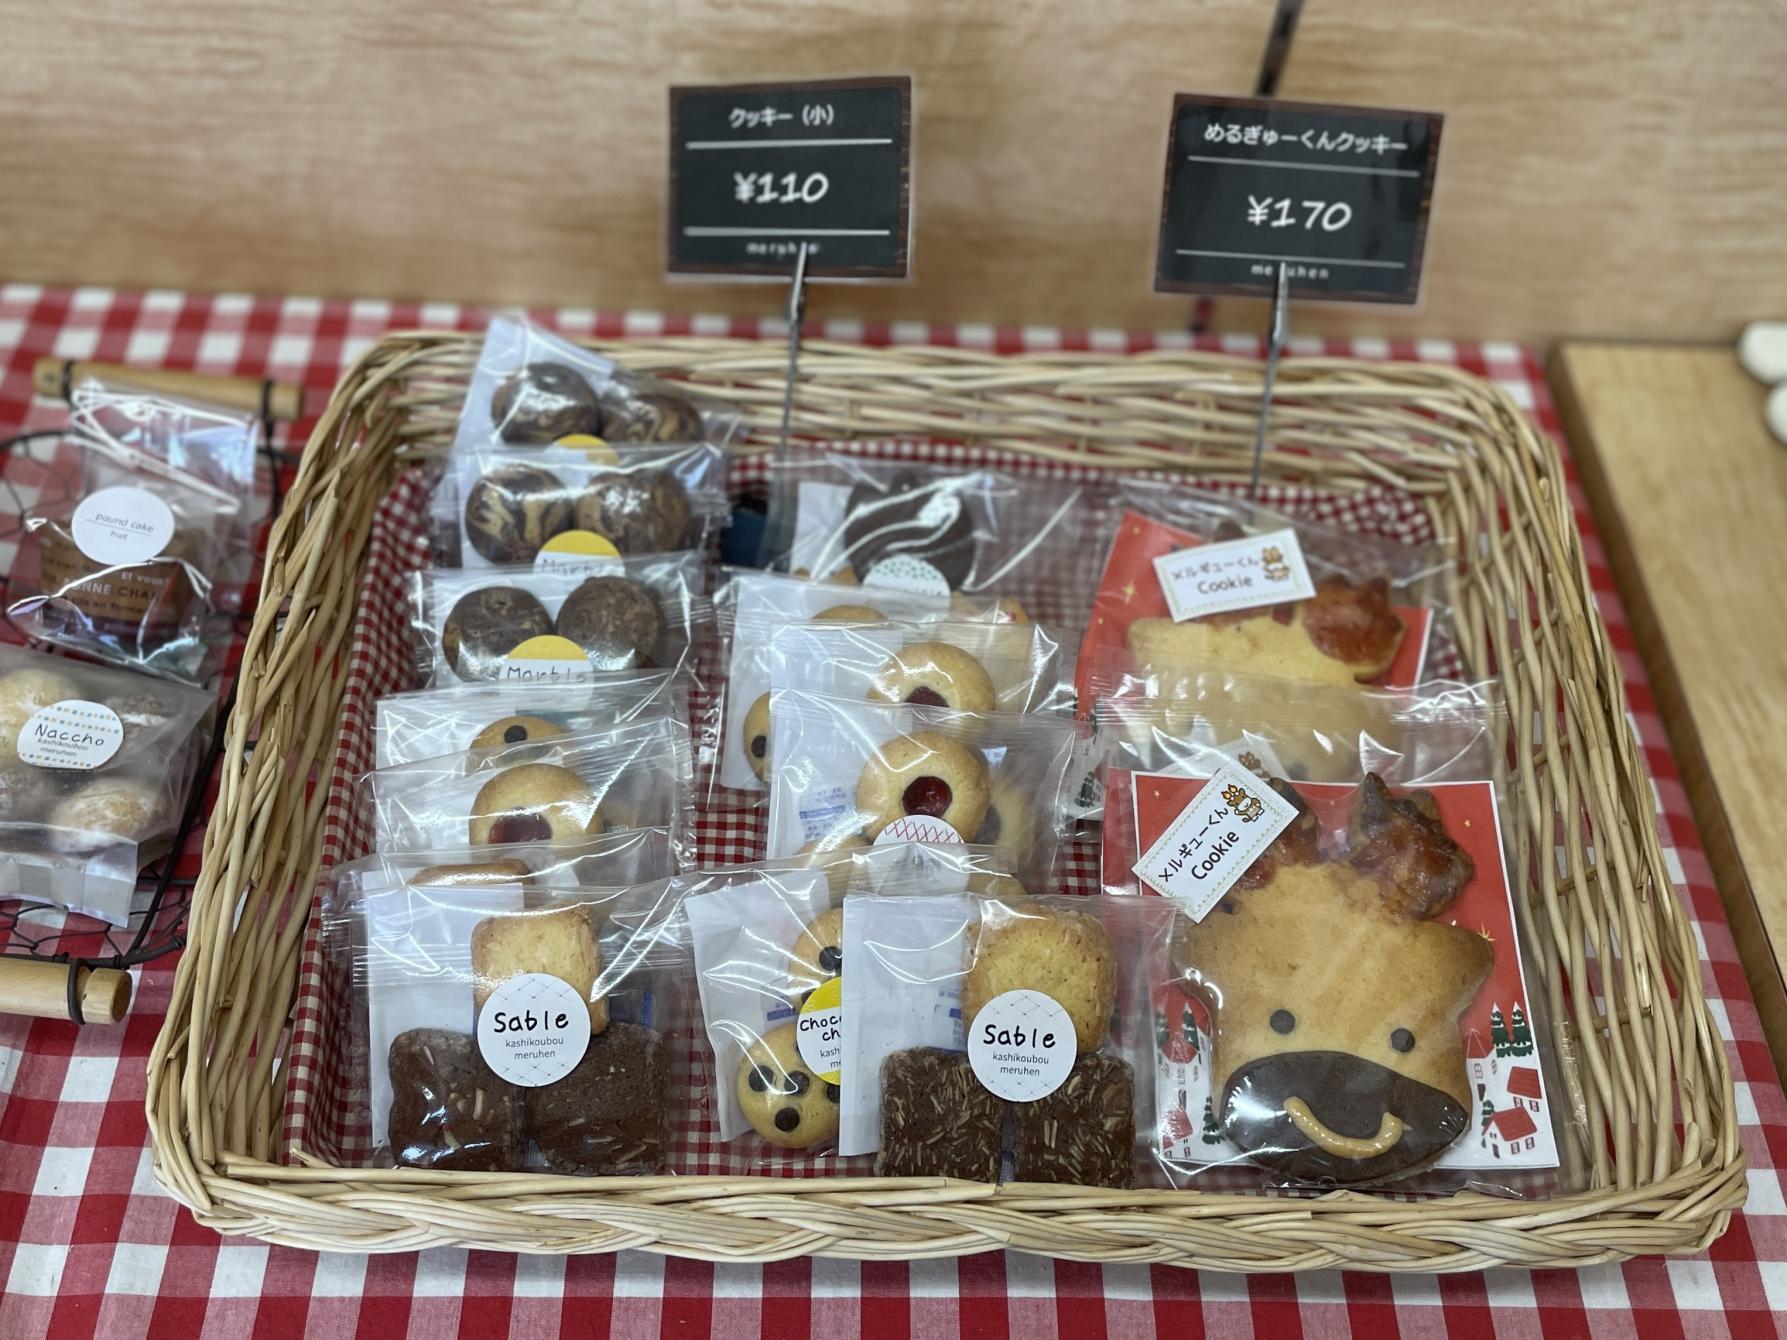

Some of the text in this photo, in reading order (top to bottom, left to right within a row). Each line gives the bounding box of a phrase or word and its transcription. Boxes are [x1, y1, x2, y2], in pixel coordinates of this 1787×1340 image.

[1204, 123, 1408, 155] めるぎゅーくんクッキー
[734, 172, 829, 203] ¥110
[1247, 195, 1352, 231] ¥170
[1251, 263, 1329, 280] meuhen
[95, 513, 154, 533] pound cake
[1197, 576, 1253, 594] Cookie
[35, 723, 105, 746] Naccho
[1158, 807, 1229, 882] メルギューくん
[1191, 831, 1240, 880] Cookie
[493, 1009, 569, 1033] Sable
[800, 1015, 842, 1032] Choc
[505, 1036, 564, 1048] kashikoubou
[983, 1023, 1057, 1049] Sable
[514, 1049, 556, 1060] meruhen
[992, 1050, 1050, 1065] kashikoubou
[1000, 1065, 1041, 1077] meruhen
